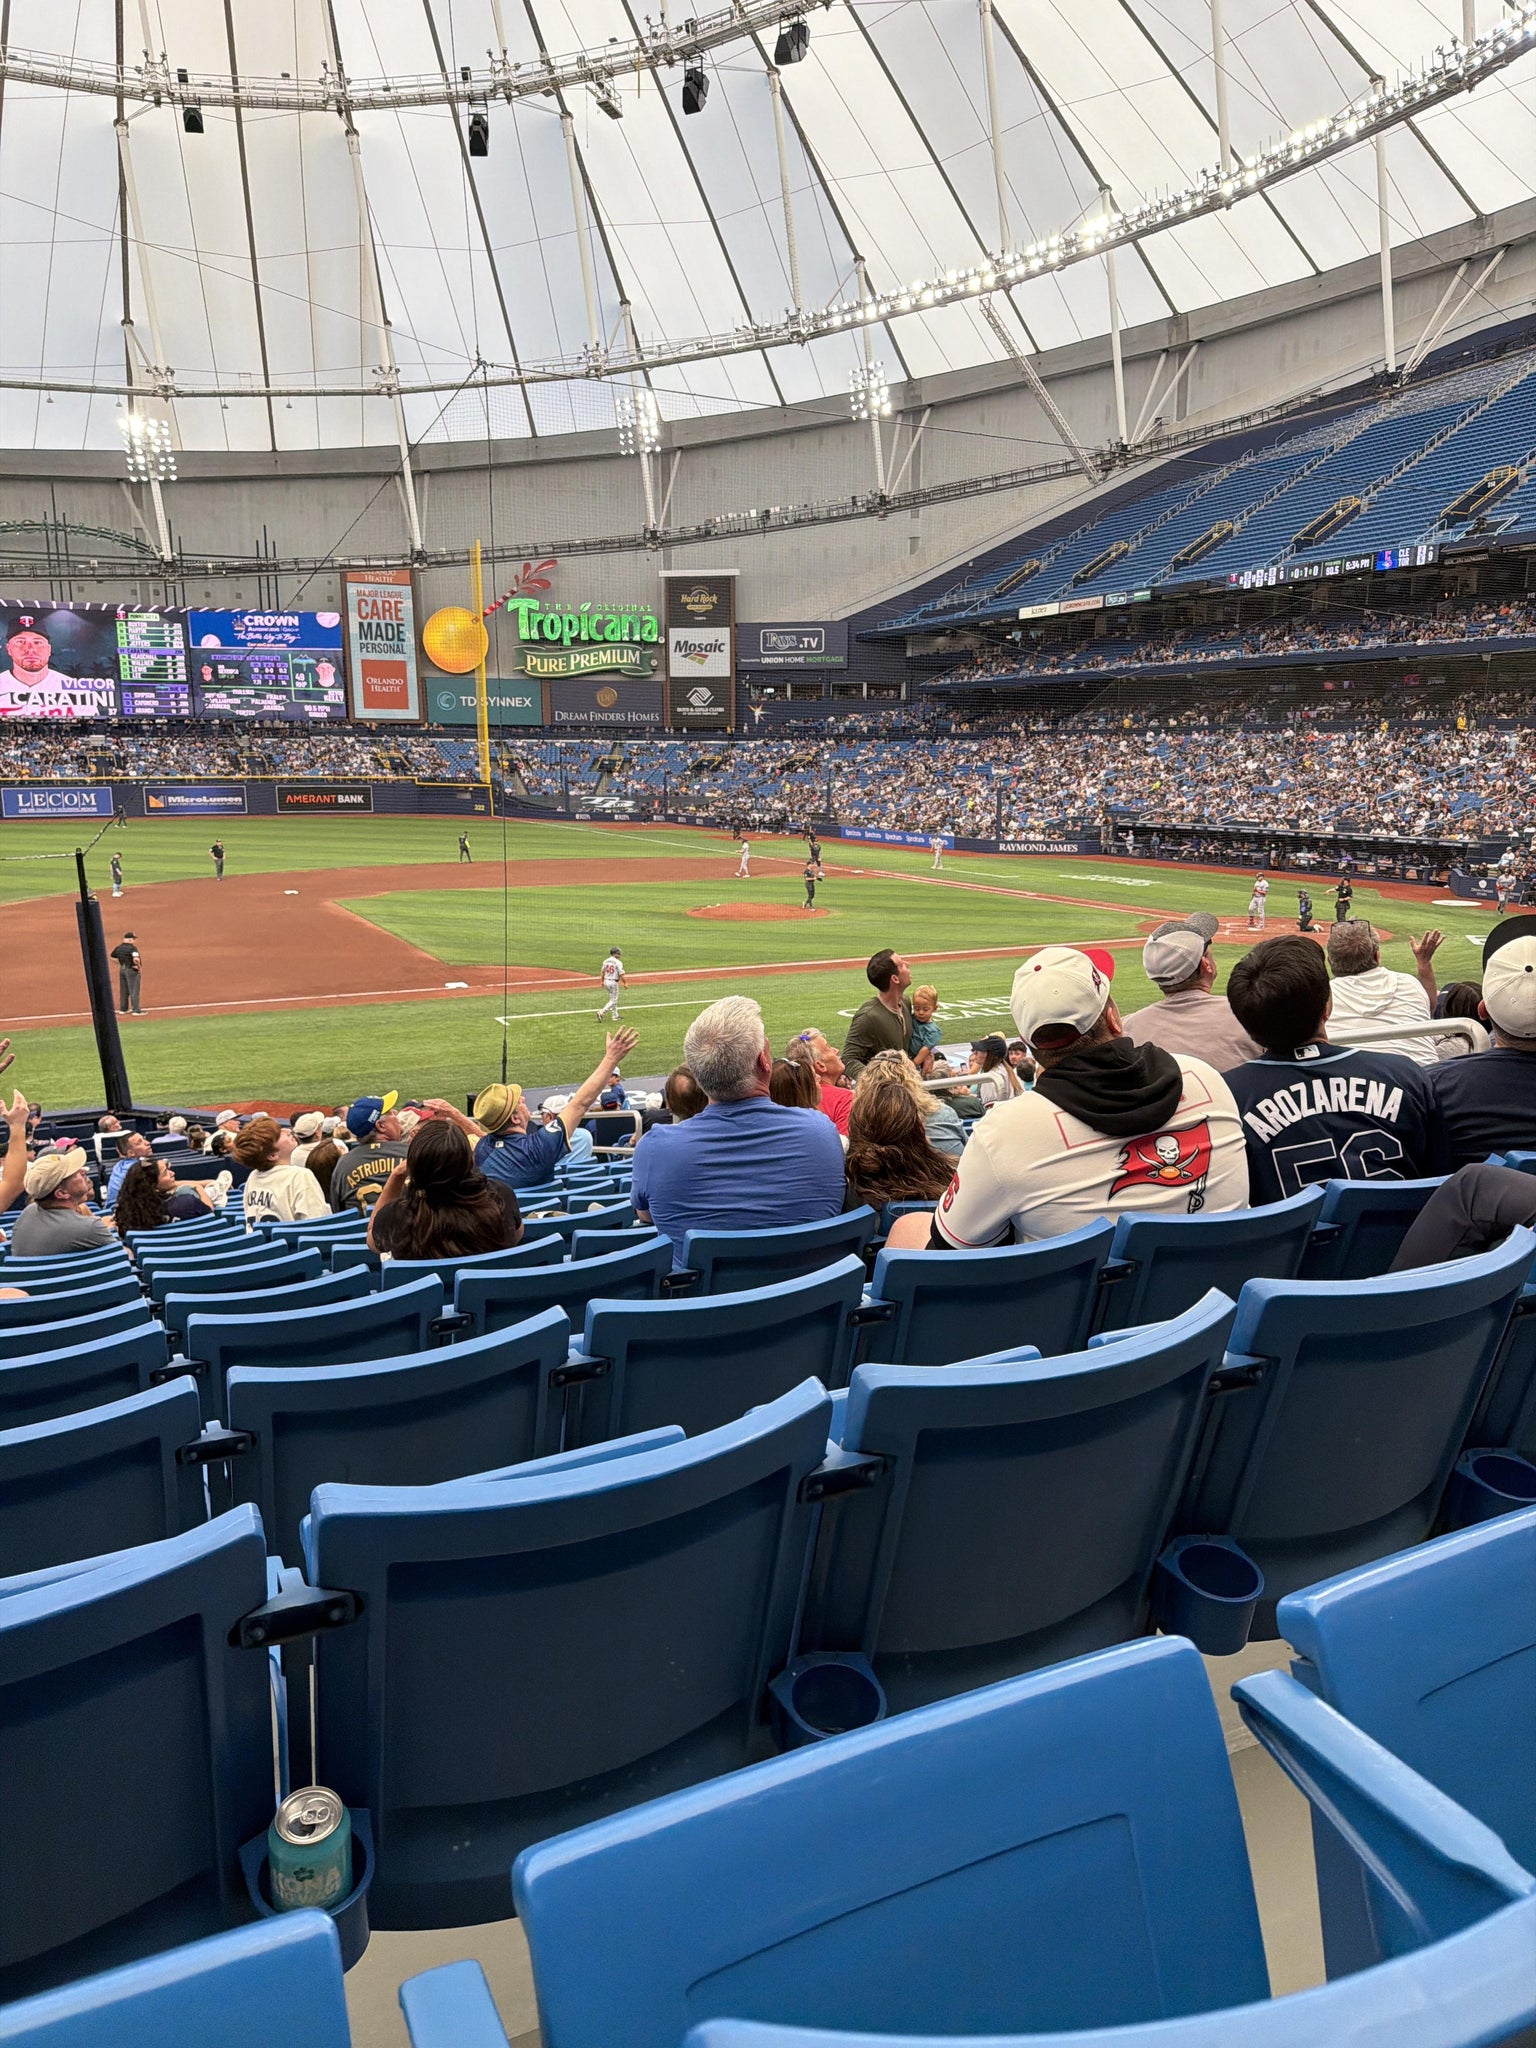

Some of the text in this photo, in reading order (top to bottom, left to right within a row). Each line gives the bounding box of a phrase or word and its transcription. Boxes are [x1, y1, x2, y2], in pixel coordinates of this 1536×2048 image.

[1399, 548, 1410, 557] CLE
[1428, 551, 1434, 561] 9
[1346, 559, 1370, 570] 6:34 PM
[1399, 558, 1409, 567] TOR
[365, 575, 394, 583] HEALTH
[356, 589, 404, 599] MAJOR LEAGUE
[681, 594, 699, 603] Hard
[357, 598, 404, 621] CARE
[244, 615, 299, 626] CROWN
[507, 598, 658, 646] Tropicana
[358, 621, 406, 642] MADE
[360, 642, 406, 654] PERSONAL
[674, 639, 725, 653] Mosaic
[799, 637, 818, 648] .TV
[526, 649, 641, 672] PURE PREMIUM
[63, 678, 115, 689] VICTOR
[366, 677, 404, 685] ORLANDO
[371, 685, 401, 693] HEALTH
[12, 690, 115, 707] CARATINI
[460, 696, 532, 707] TD SYNNEX
[555, 711, 660, 721] DREAM FINDERS HOMES
[17, 792, 97, 807] LECOM
[285, 794, 364, 803] AMERANT BANK
[999, 843, 1078, 853] RAYMOND JAMES
[1243, 1077, 1403, 1144] AROZARENA
